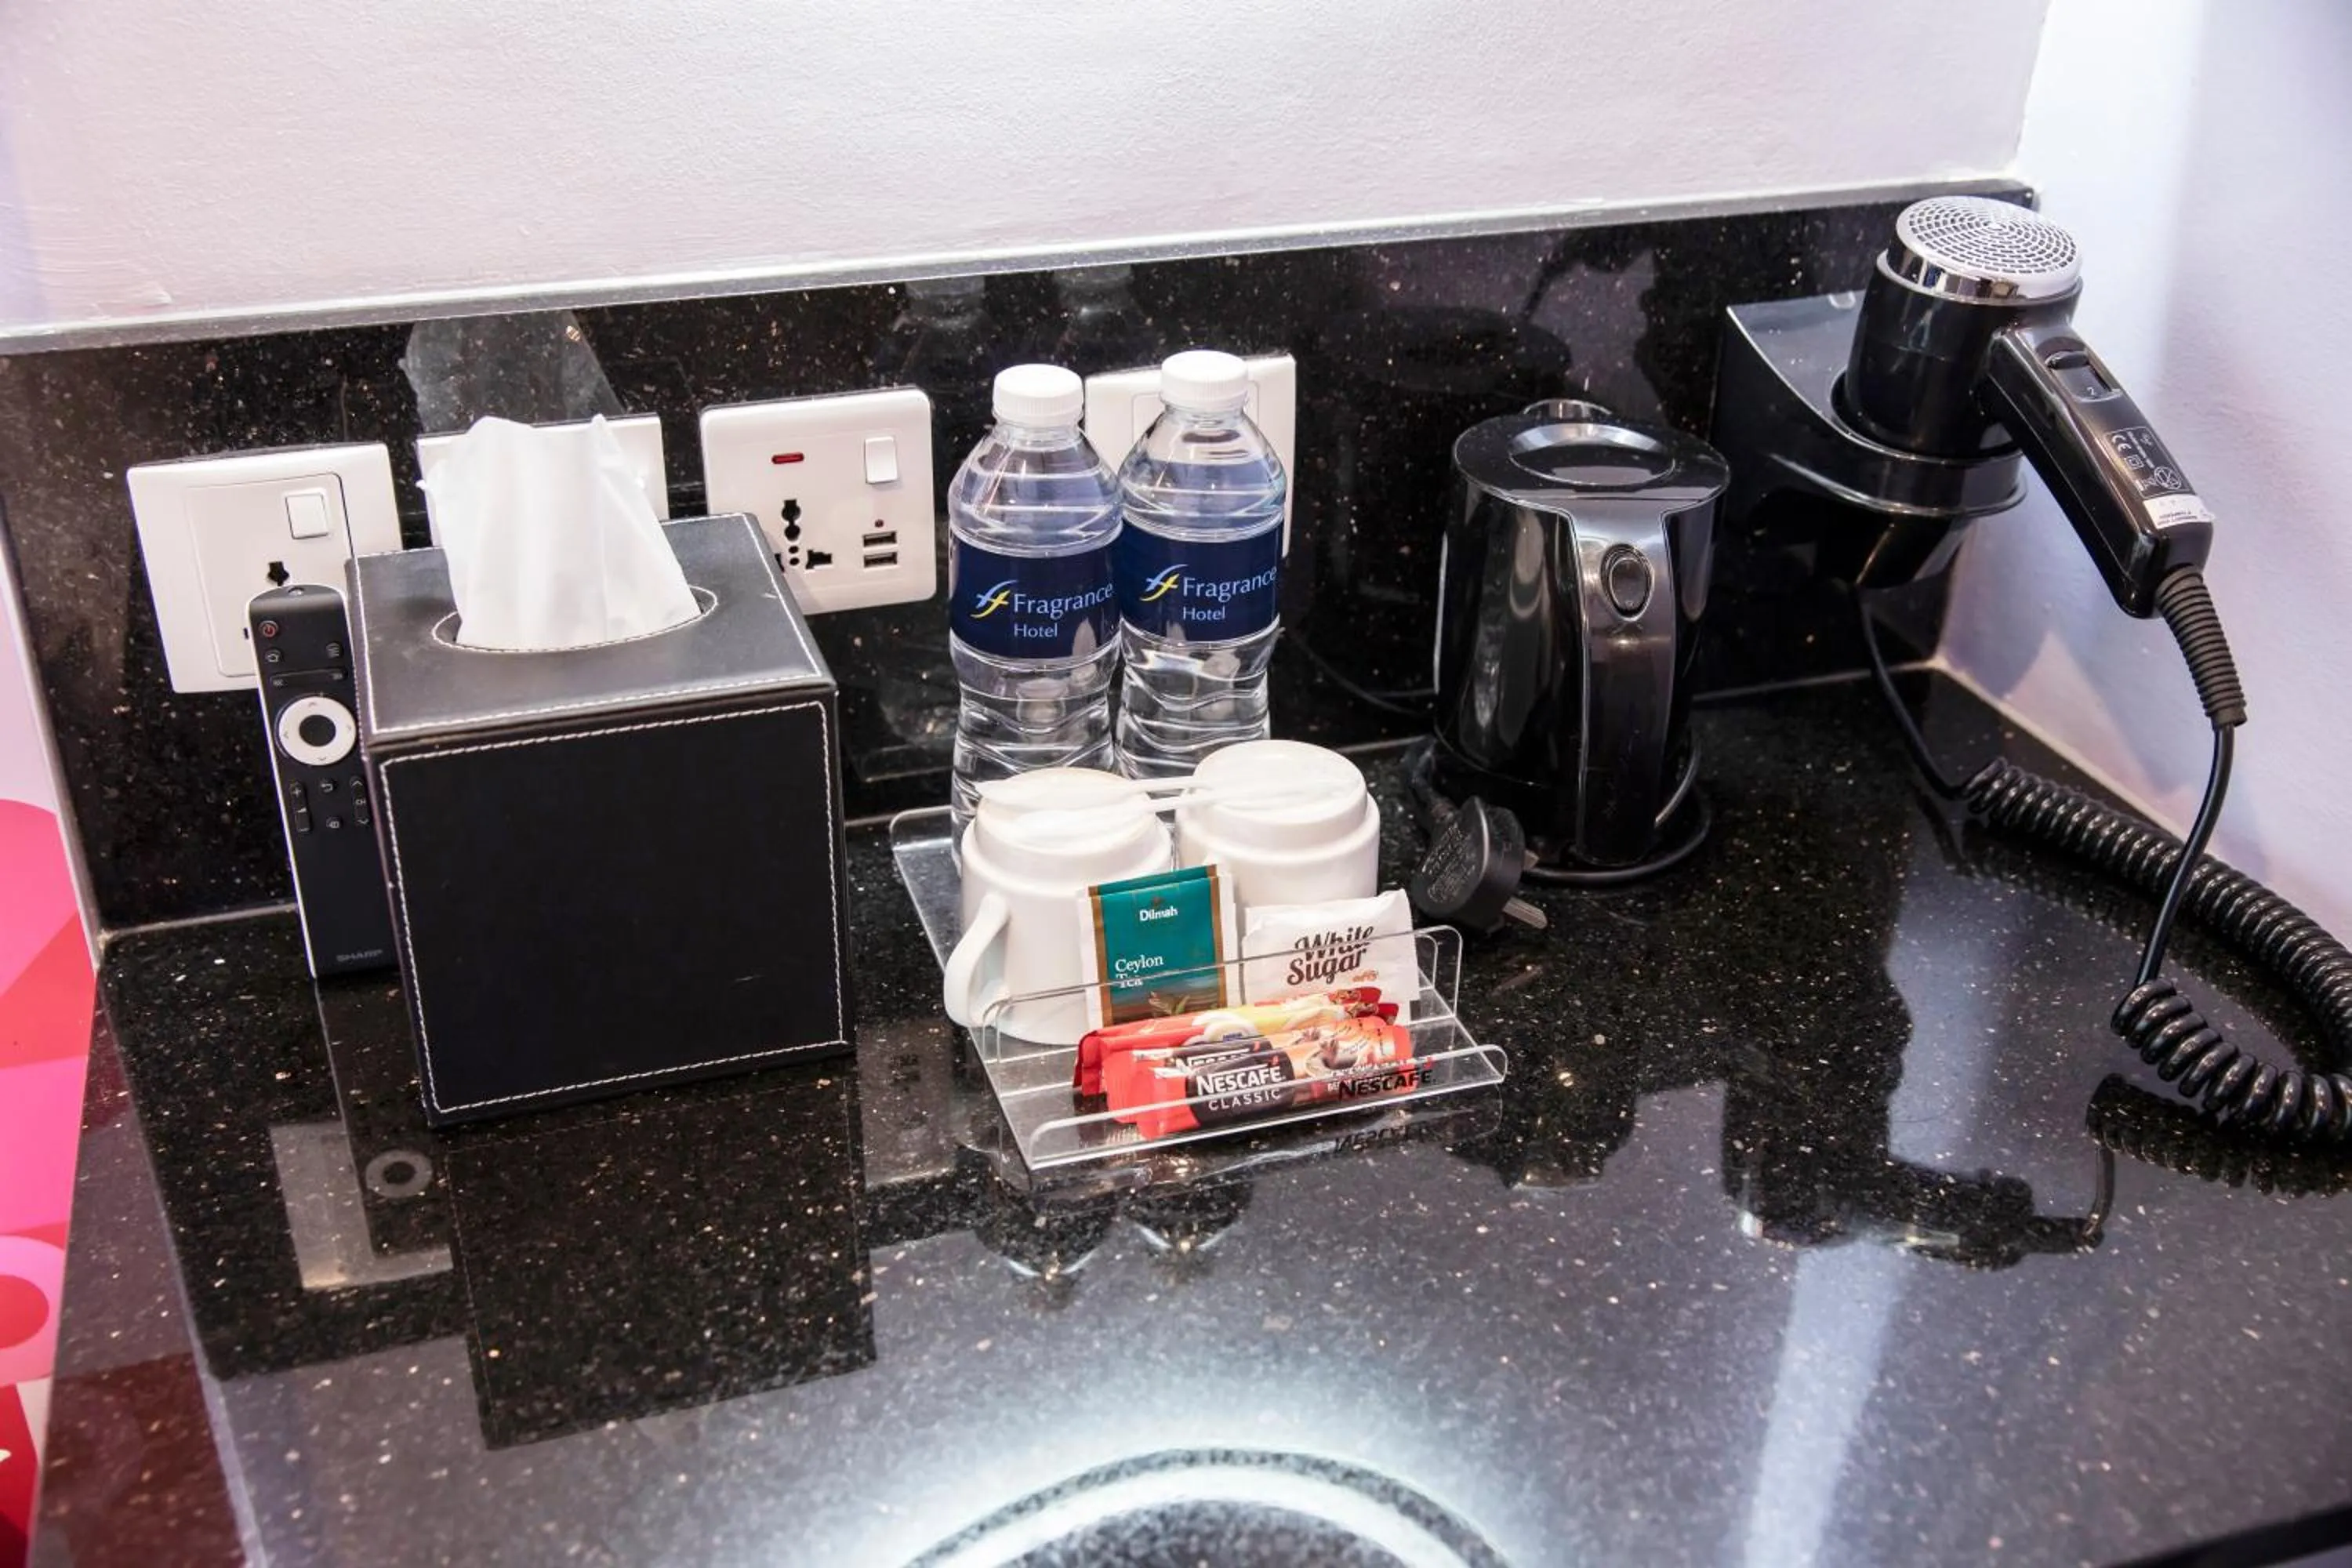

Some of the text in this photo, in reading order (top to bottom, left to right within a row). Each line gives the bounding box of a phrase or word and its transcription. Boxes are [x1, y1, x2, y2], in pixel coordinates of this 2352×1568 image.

[1182, 566, 1278, 603] Fragrance
[1014, 583, 1113, 620] Fragrance
[1183, 605, 1226, 621] Hotel
[1014, 623, 1058, 638] Hotel
[1294, 925, 1374, 961] White
[1115, 954, 1164, 973] Ceylon
[1286, 948, 1367, 985] Sugar
[1208, 1089, 1280, 1111] CLASSIC
